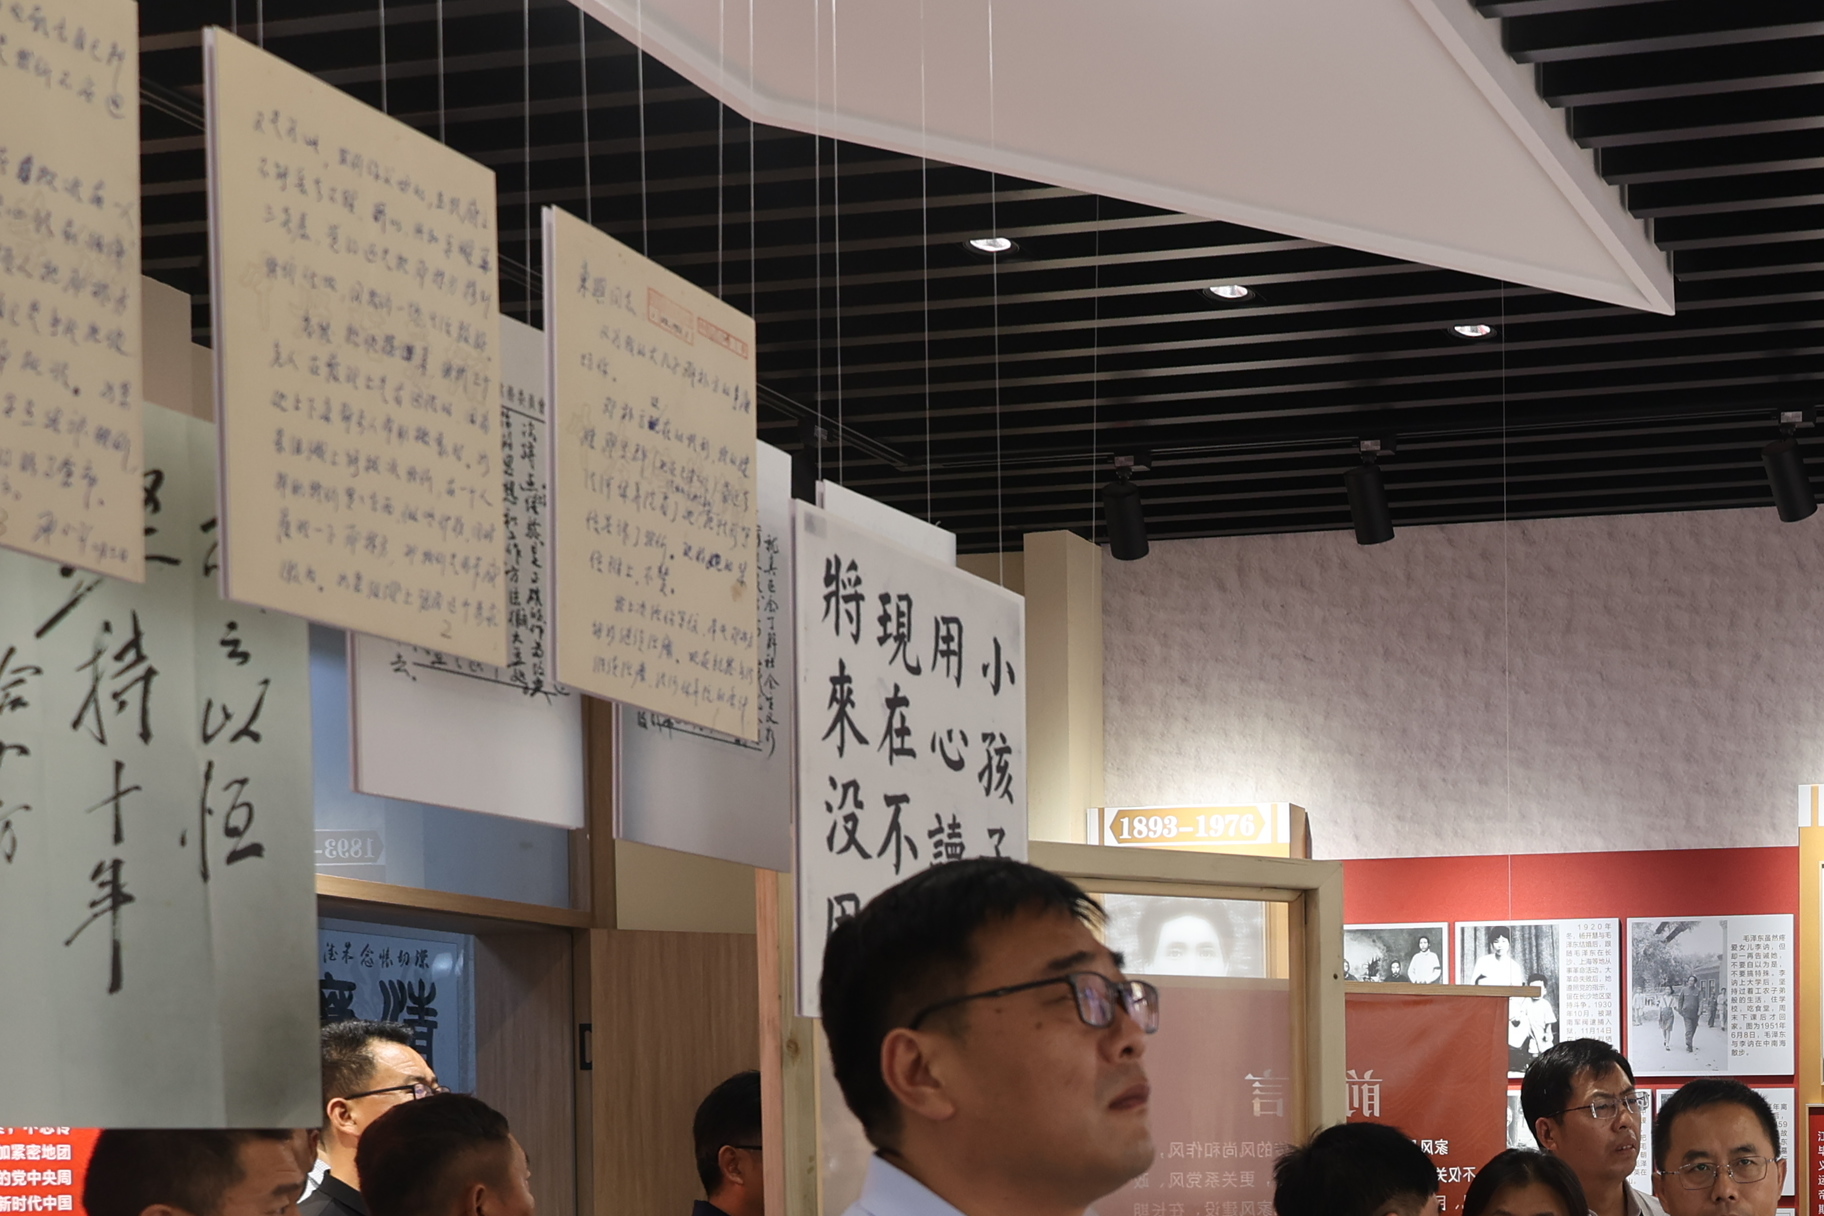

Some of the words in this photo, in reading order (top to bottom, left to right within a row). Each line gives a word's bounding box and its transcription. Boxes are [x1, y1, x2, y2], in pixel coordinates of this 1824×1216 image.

[876, 592, 921, 876] 現在不
[1119, 813, 1255, 840] 1893-1976
[1577, 923, 1613, 931] 1920年
[1742, 934, 1787, 942] 毛泽东虽然疼
[1565, 949, 1613, 957] 随毛泽东在长
[1730, 961, 1783, 969] 不要自以为是，
[1730, 987, 1787, 995] 持过着工农子弟
[1730, 1022, 1787, 1030] 家。图为1951年
[1730, 1031, 1787, 1039] 6月8日，毛泽东
[1730, 1040, 1787, 1048] 与李讷在中南海
